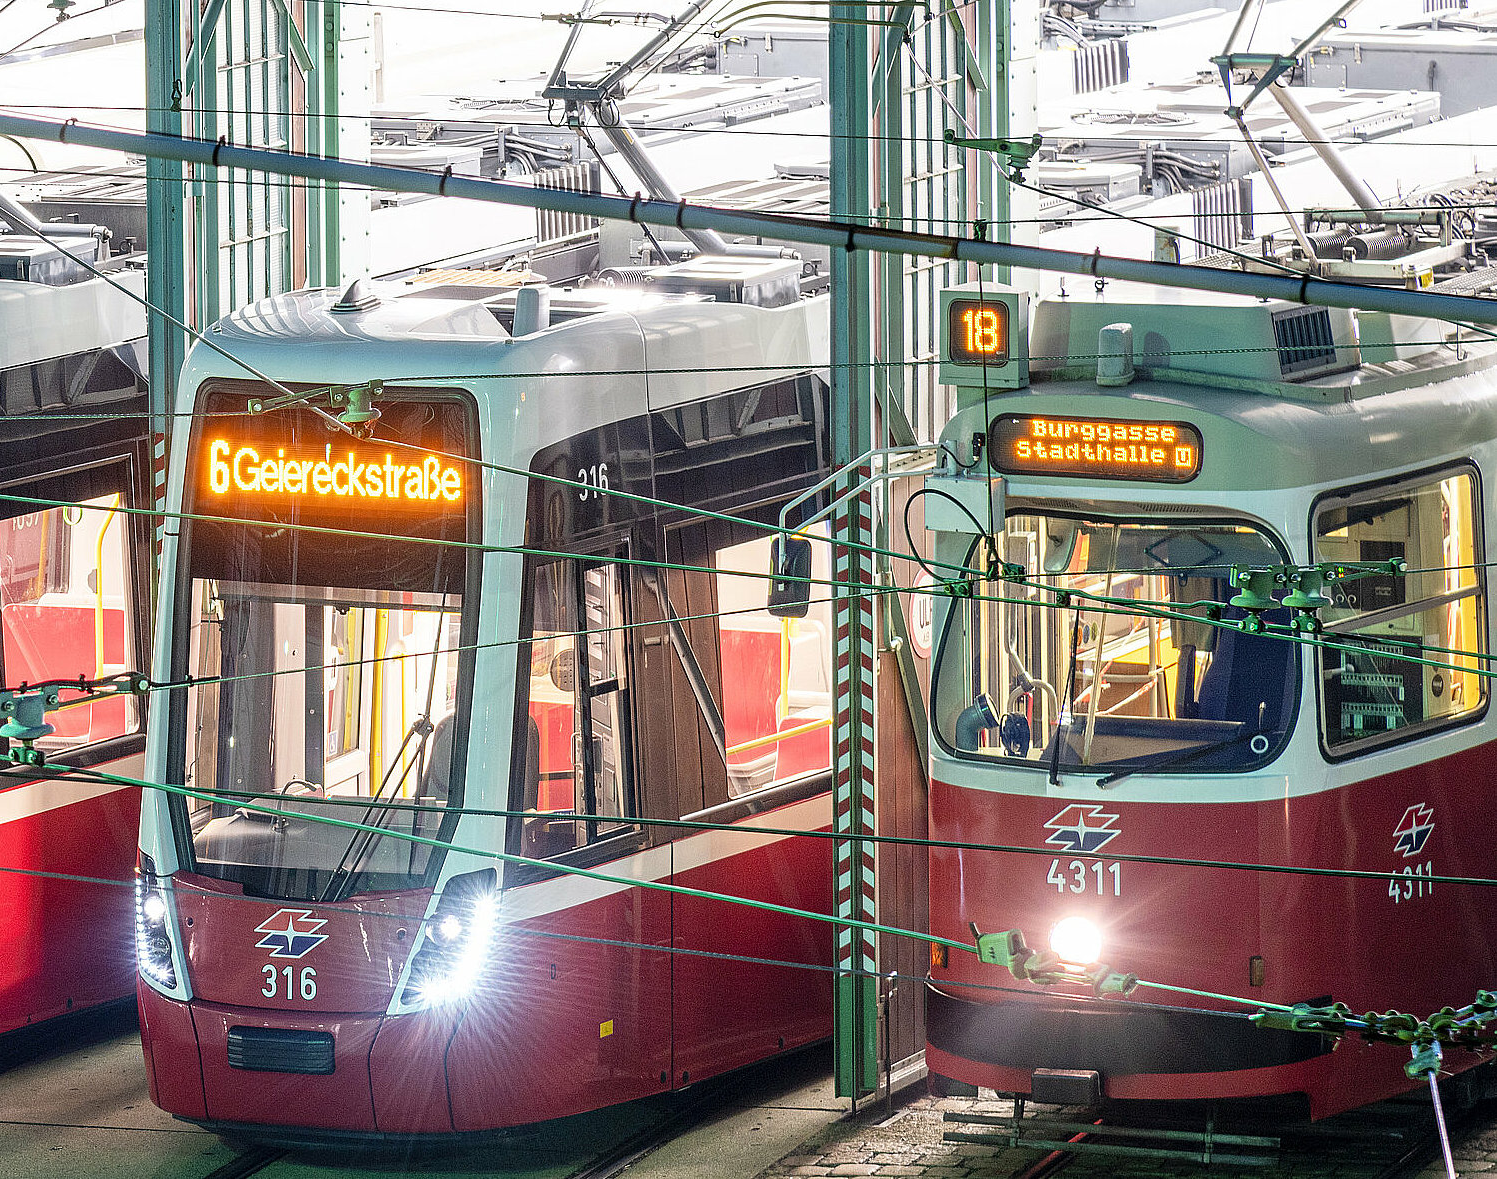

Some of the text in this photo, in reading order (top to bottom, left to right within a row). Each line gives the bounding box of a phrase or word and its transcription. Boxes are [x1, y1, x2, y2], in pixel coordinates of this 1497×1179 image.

[963, 309, 999, 352] 18
[1032, 419, 1176, 442] Burggasse
[210, 440, 461, 500] 6 Geiereckstraße
[1016, 440, 1165, 464] Stadthalle
[578, 462, 609, 501] 316
[1046, 858, 1121, 897] 4311
[1388, 860, 1433, 904] 4311
[261, 963, 318, 1001] 316
